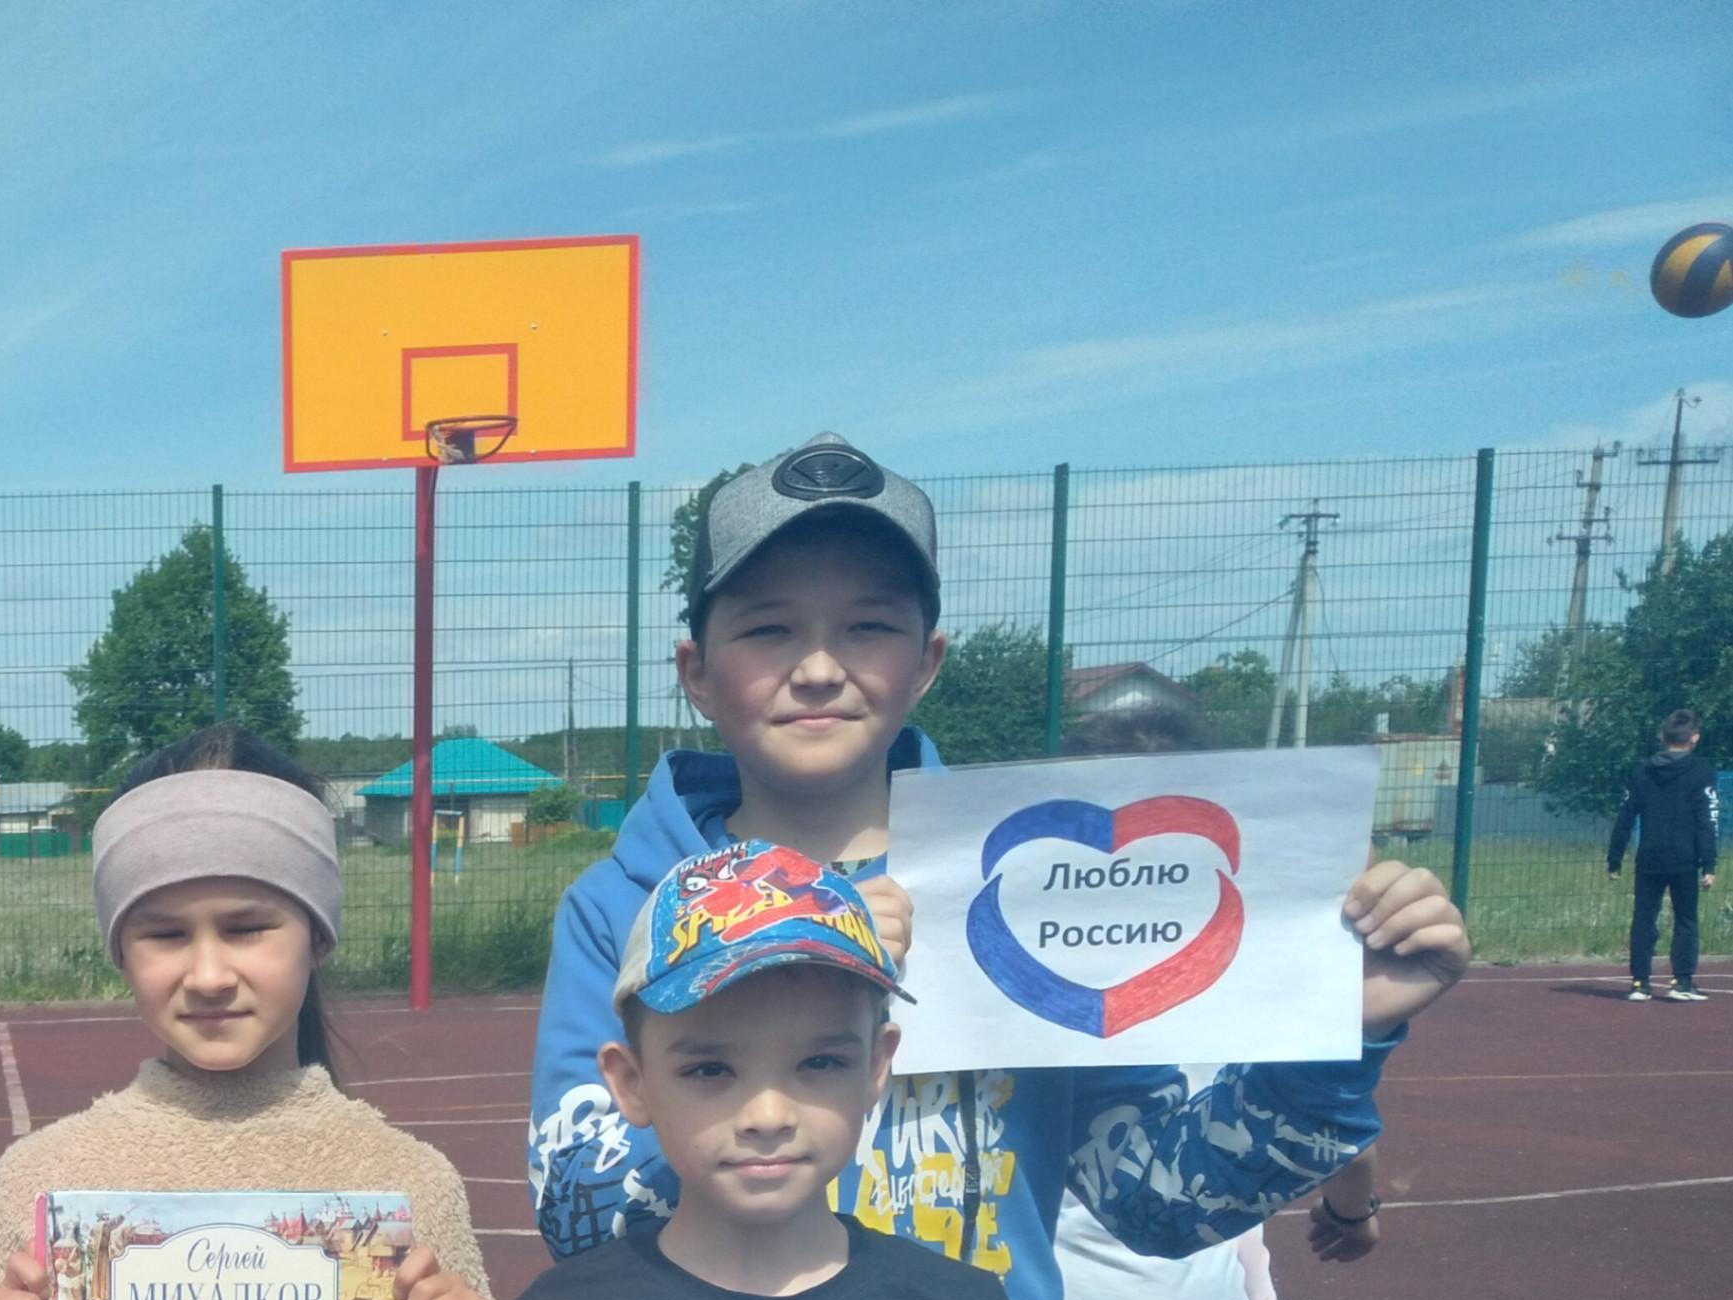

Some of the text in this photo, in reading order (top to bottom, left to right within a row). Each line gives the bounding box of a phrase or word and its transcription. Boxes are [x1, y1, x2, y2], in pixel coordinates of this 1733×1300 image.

[1042, 857, 1190, 891] Люблю
[1038, 920, 1183, 949] Россию
[187, 1237, 267, 1280] Сергей
